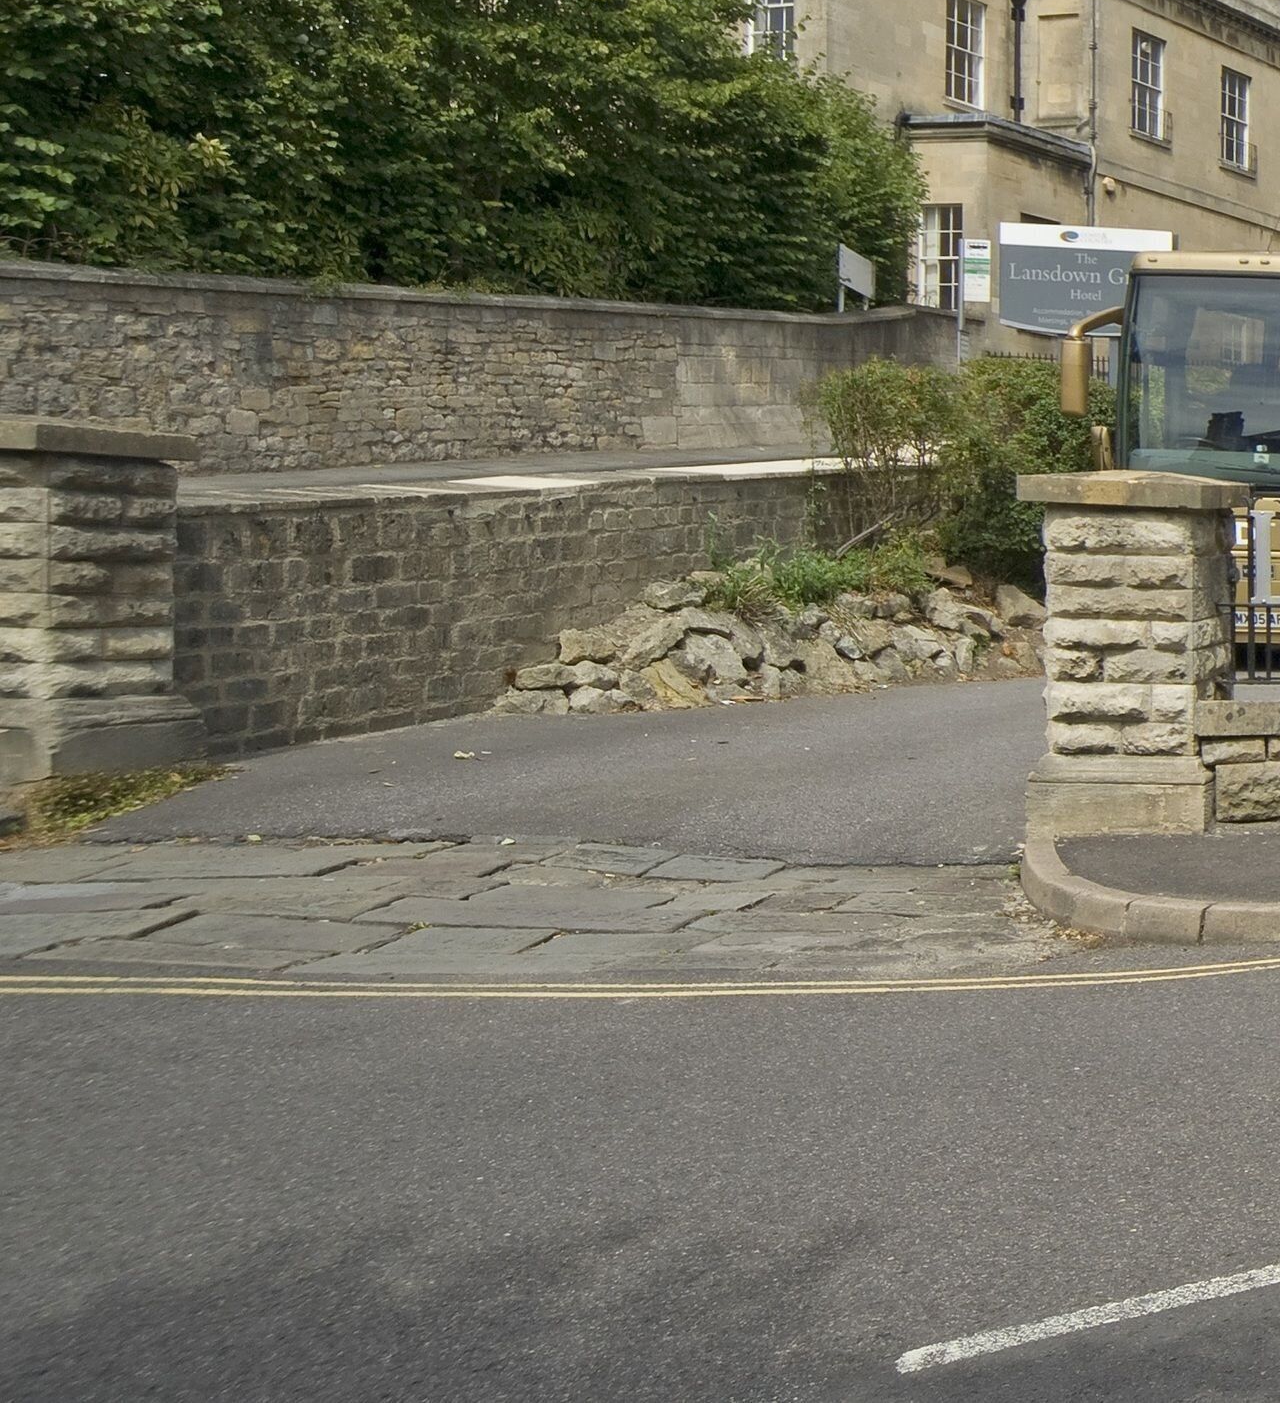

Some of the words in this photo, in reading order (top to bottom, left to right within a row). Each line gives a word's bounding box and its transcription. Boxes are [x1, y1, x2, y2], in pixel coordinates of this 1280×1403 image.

[1074, 252, 1098, 264] The
[1009, 262, 1101, 284] Lansdown
[1070, 289, 1102, 301] Hotel
